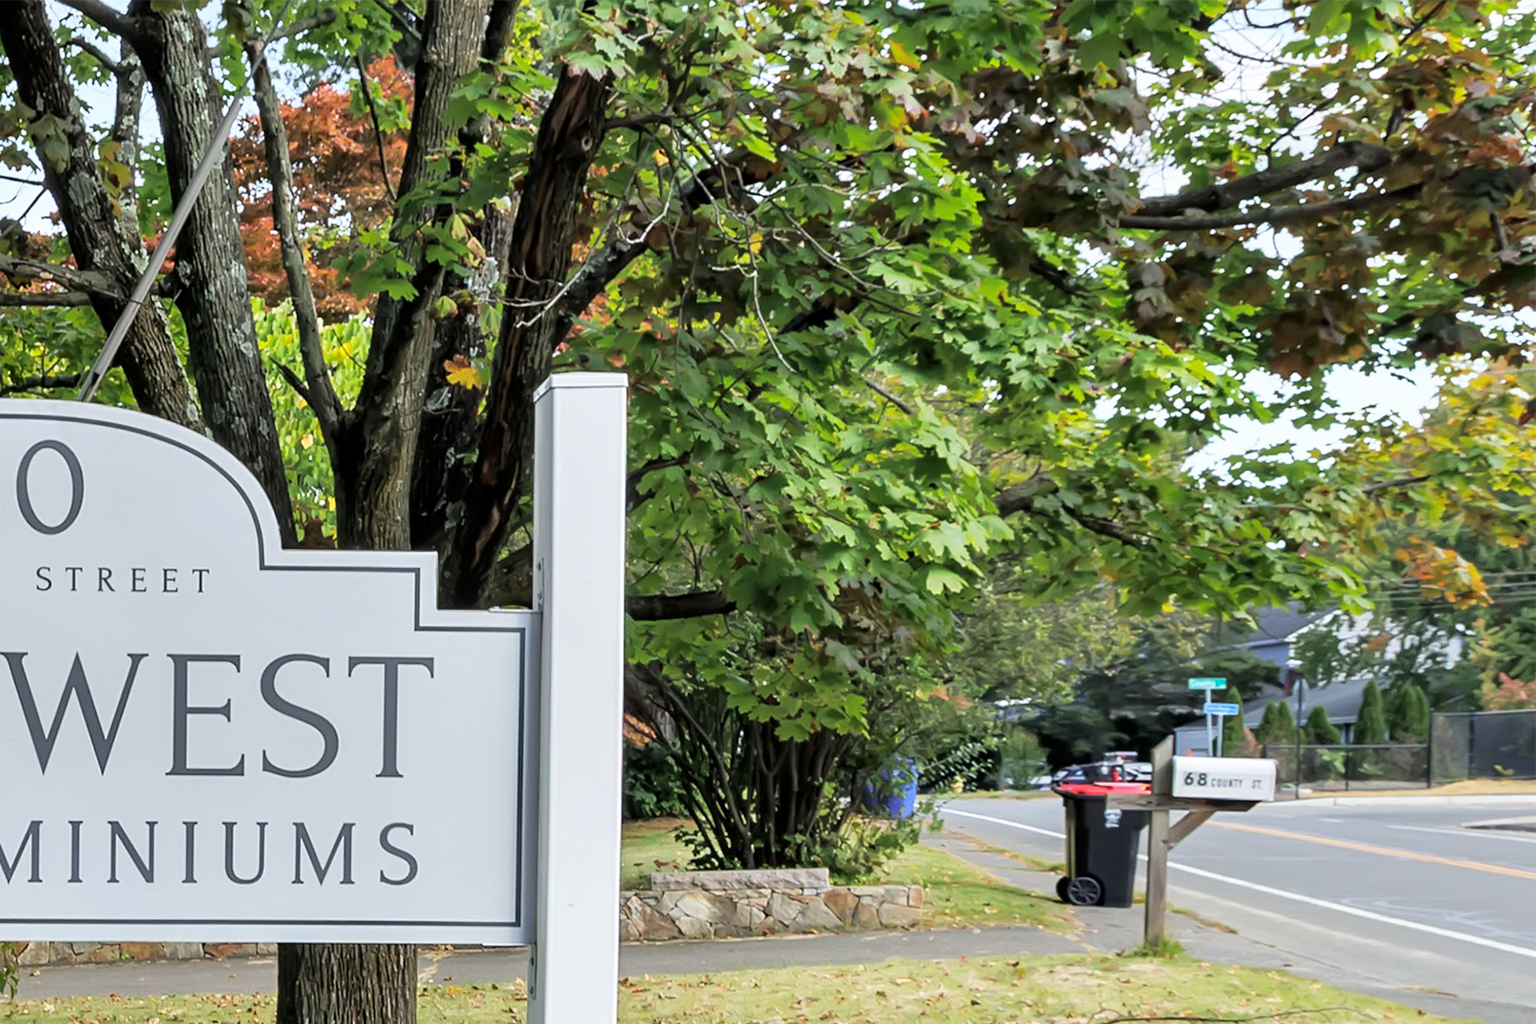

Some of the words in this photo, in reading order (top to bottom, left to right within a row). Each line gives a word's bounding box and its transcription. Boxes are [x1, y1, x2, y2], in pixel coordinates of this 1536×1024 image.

[36, 566, 211, 594] STREET
[1183, 772, 1208, 786] 68
[1211, 778, 1243, 788] COUNTY
